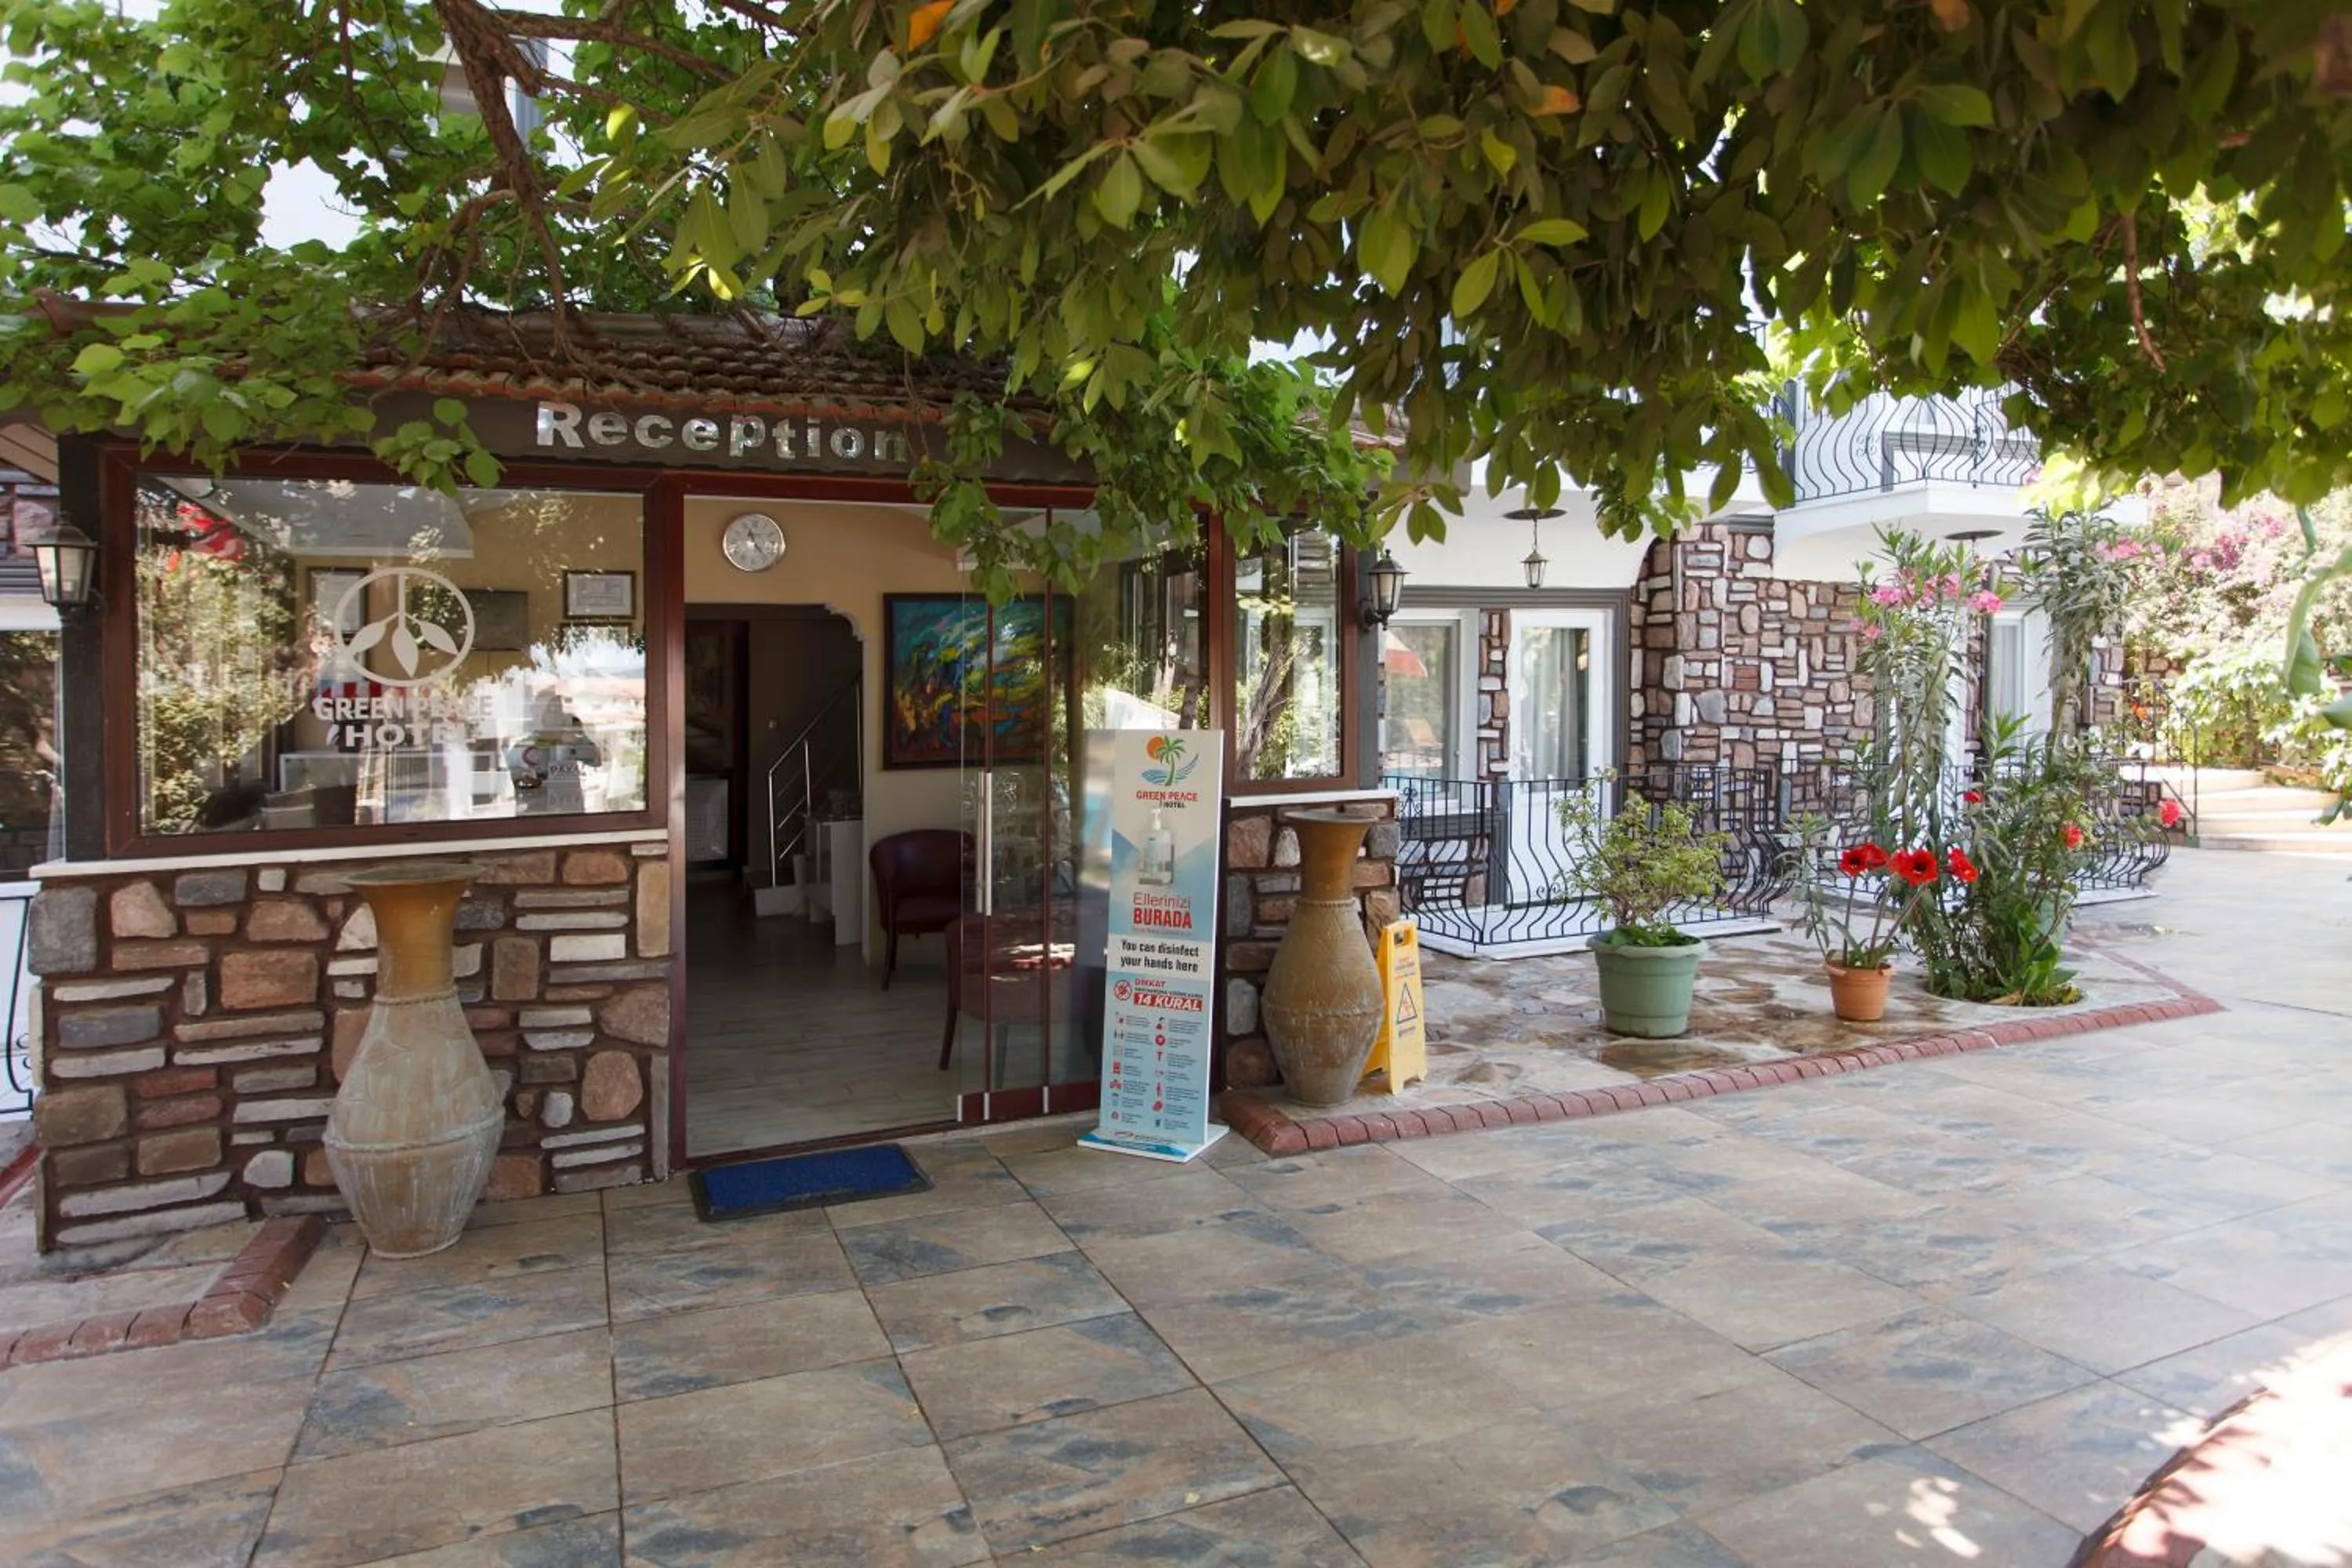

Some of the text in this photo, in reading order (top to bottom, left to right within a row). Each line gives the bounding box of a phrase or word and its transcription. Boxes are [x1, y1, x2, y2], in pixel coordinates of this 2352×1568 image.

[537, 401, 908, 462] Reception
[315, 696, 404, 720] GREEN
[1136, 790, 1198, 801] GREEN PEACE
[1133, 892, 1191, 909] Ellerinizi
[1133, 908, 1192, 928] BURADA
[1121, 939, 1199, 957] You can disinfect
[1120, 956, 1199, 972] your hands here
[1137, 993, 1152, 1006] 14
[1155, 995, 1200, 1011] KURAL
